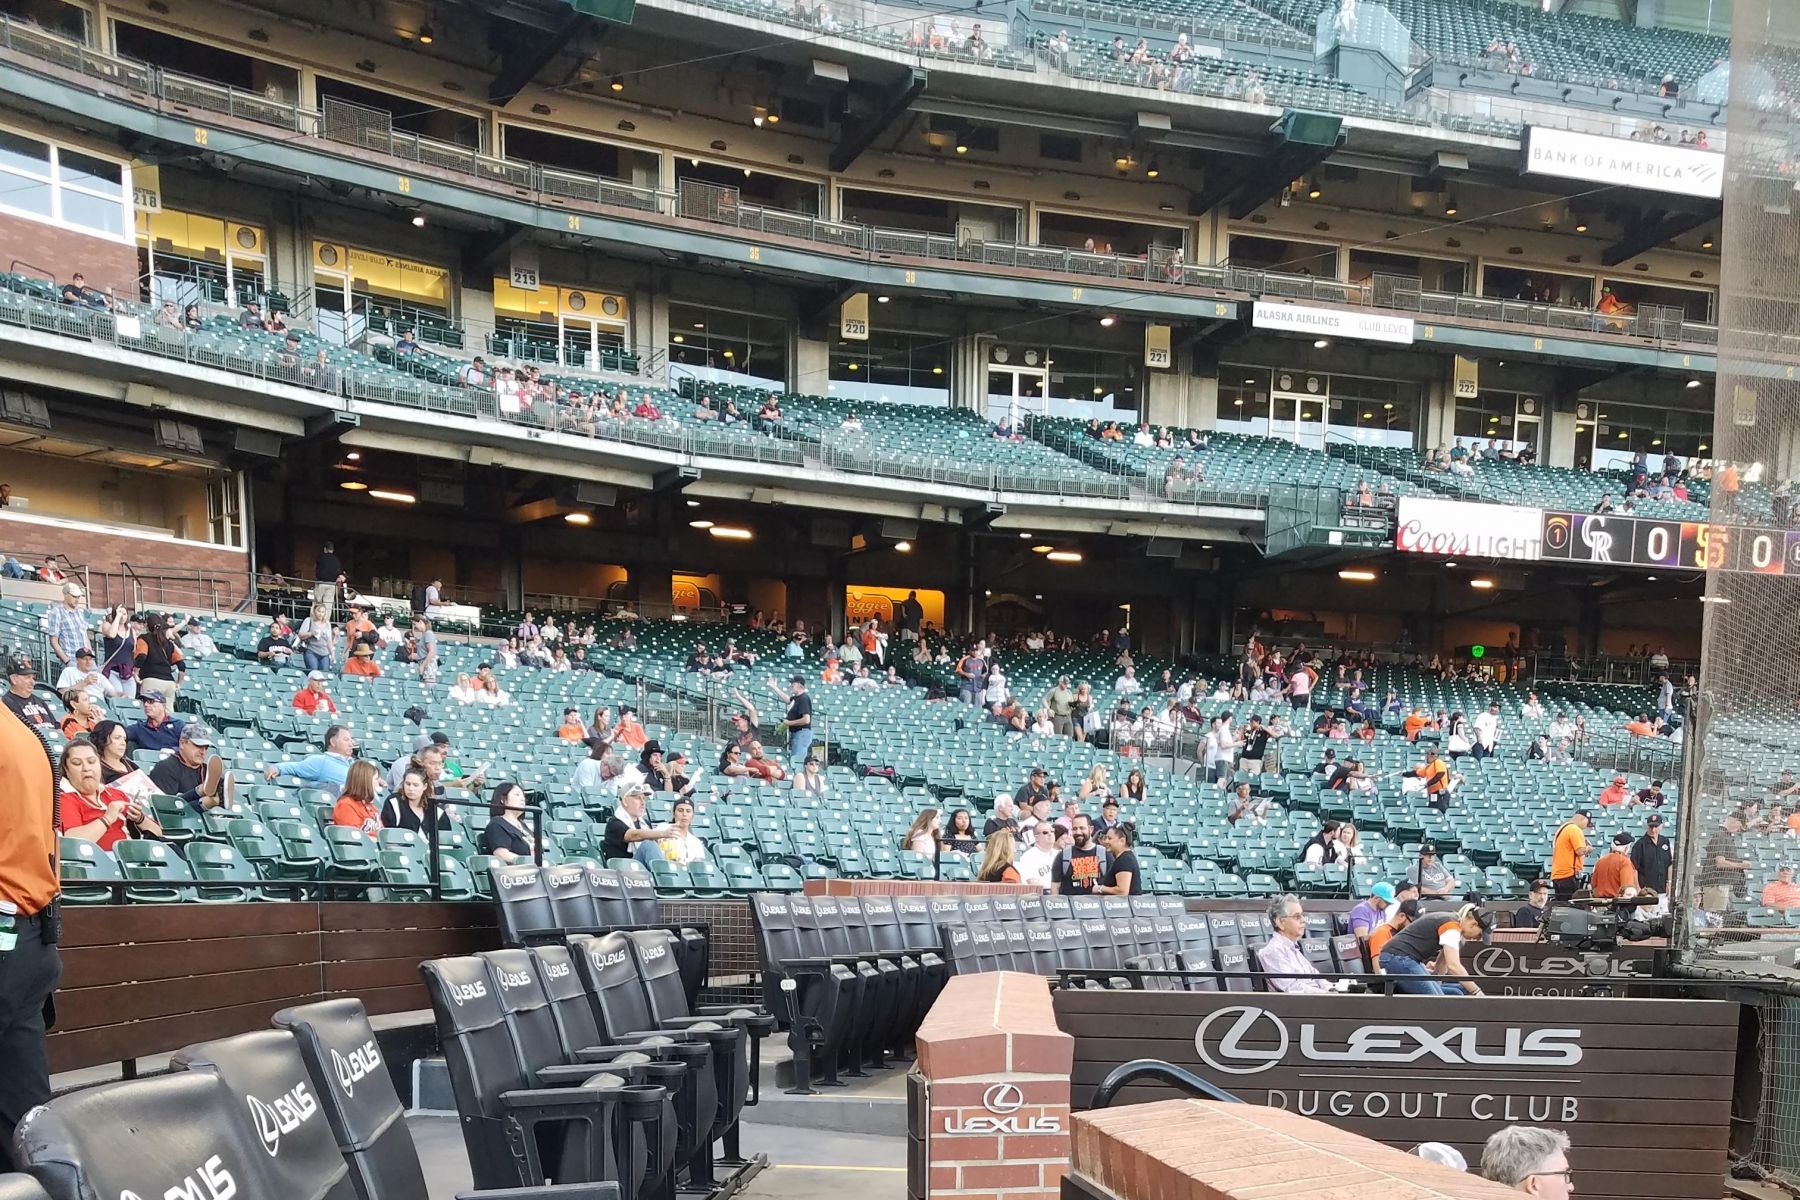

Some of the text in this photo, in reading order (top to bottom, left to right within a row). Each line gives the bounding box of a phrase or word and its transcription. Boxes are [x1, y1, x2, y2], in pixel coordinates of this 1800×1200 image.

[194, 127, 208, 145] 32
[1533, 147, 1683, 179] BANK OF AMERICA
[132, 193, 158, 208] 218
[514, 272, 536, 286] 219
[845, 324, 866, 335] 220
[1256, 309, 1410, 335] ALASKA AIRLINES CLUB LEVEL
[1150, 352, 1168, 363] 221
[1458, 384, 1476, 394] 222
[1397, 519, 1542, 561] Coors LIGHT
[1553, 527, 1561, 543] 1
[1647, 527, 1668, 561] 0
[1752, 535, 1772, 568] 0
[847, 601, 888, 614] oggie
[511, 874, 537, 886] LEXUS
[559, 874, 581, 885] LEXUS
[598, 878, 620, 887] LEXUS
[631, 879, 650, 887] LEXUS
[602, 949, 626, 966] LEXUS
[647, 945, 666, 960] LEXUS
[550, 962, 570, 977] LEXUS
[506, 971, 532, 987] LEXUS
[456, 980, 487, 1000] LEXUS
[1300, 1023, 1583, 1066] LEXUS
[348, 1040, 381, 1083] LEXUS
[267, 1081, 317, 1135] LEXUS
[1267, 1089, 1579, 1123] DUGOUT CLUB
[944, 1116, 1061, 1134] LEXUS
